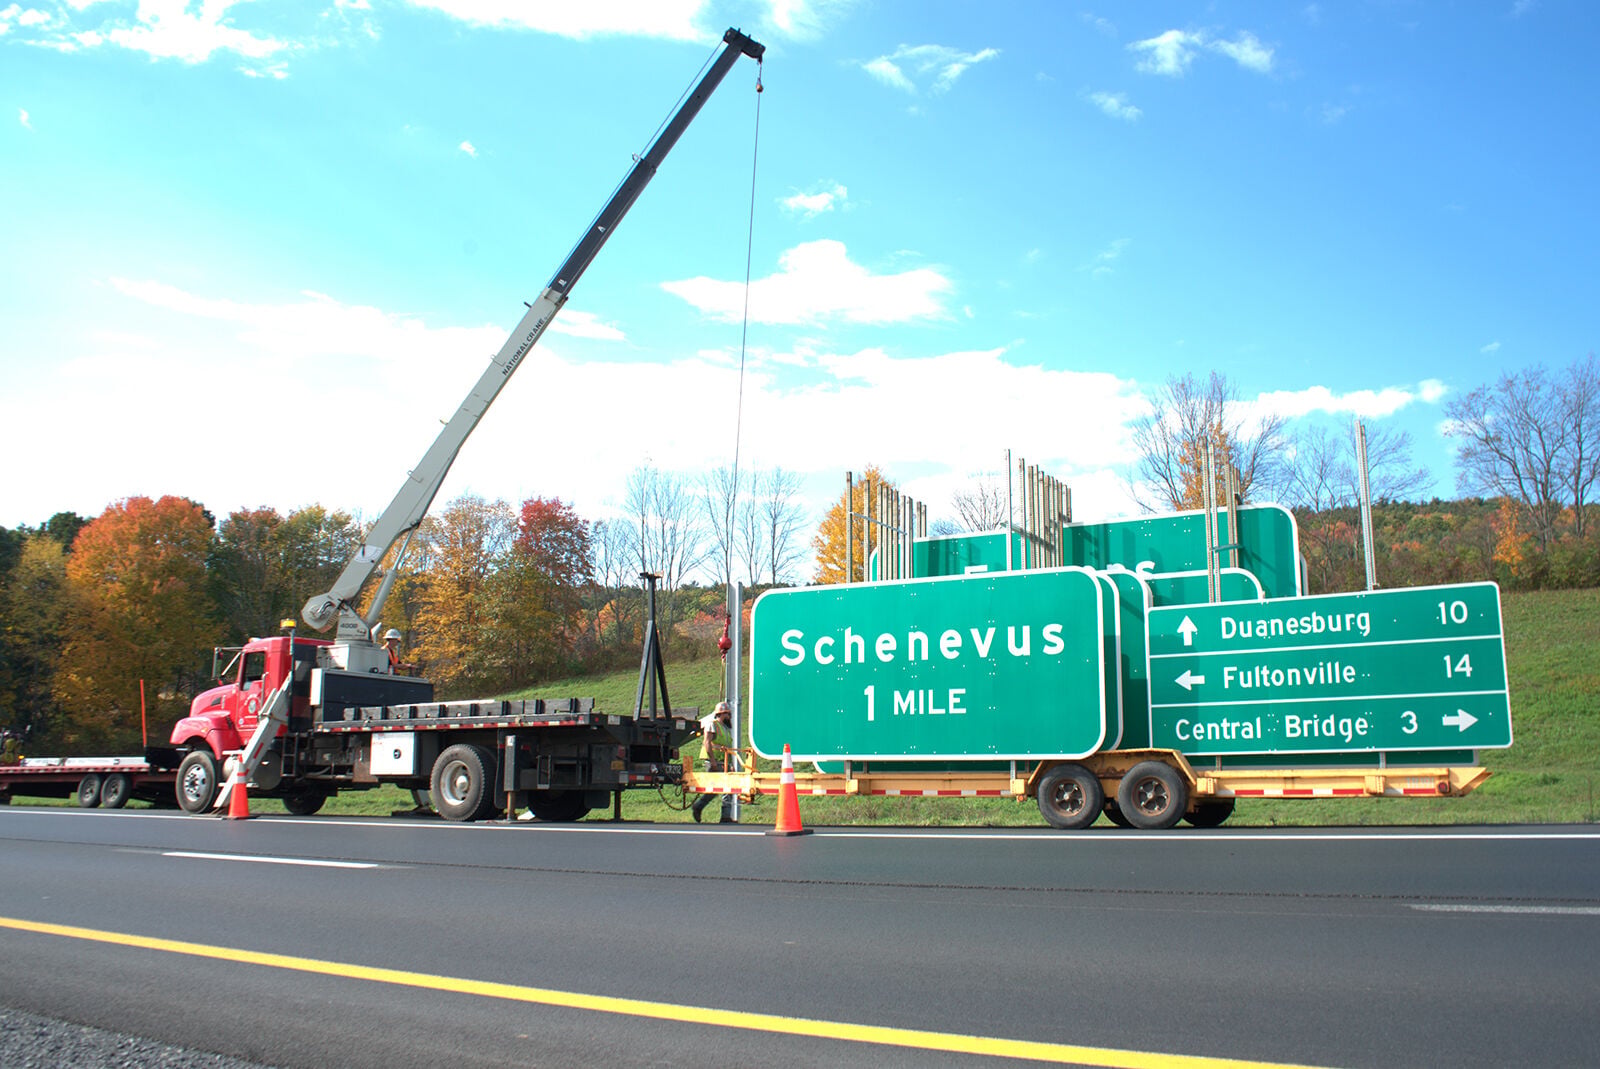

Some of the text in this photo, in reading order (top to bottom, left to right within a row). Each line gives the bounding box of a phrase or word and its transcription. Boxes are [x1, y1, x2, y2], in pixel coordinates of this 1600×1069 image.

[502, 318, 545, 376] NATIONAL CRANE
[1221, 601, 1468, 637] Duanesburg 10
[780, 623, 1065, 666] Schenevus
[1223, 654, 1473, 689] Fultonville 14
[864, 685, 967, 721] 1 MILE
[1175, 710, 1418, 742] Central Bridge 3
